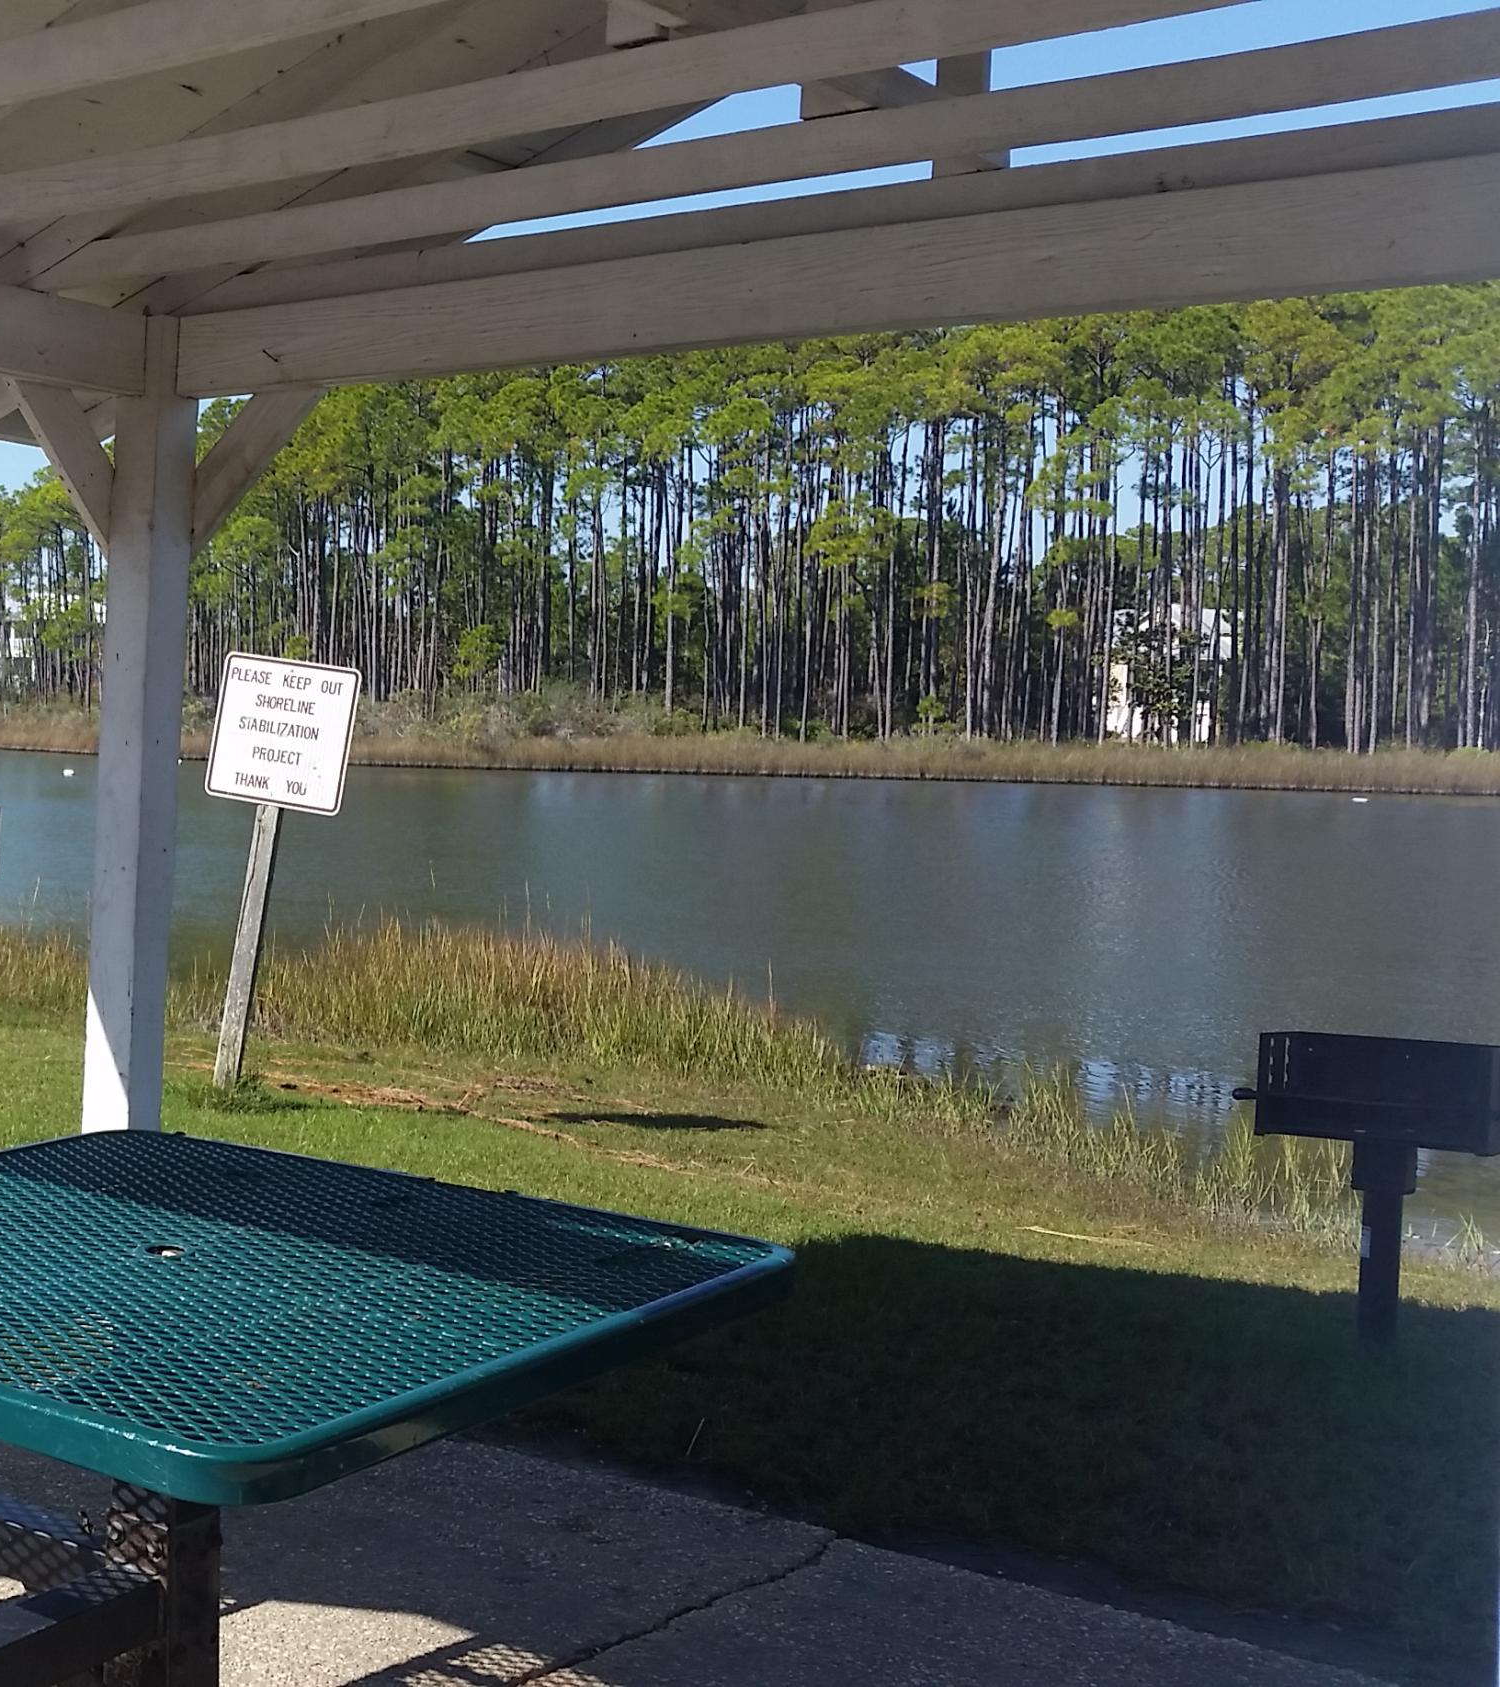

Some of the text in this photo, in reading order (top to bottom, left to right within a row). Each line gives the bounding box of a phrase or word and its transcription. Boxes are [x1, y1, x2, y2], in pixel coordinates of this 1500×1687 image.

[230, 666, 344, 696] PLEASE KEEP OUT
[255, 693, 316, 716] SHORELINE
[238, 716, 320, 741] STABILIZATION
[252, 746, 303, 766] PROJECT
[234, 771, 307, 796] THANK YOU
